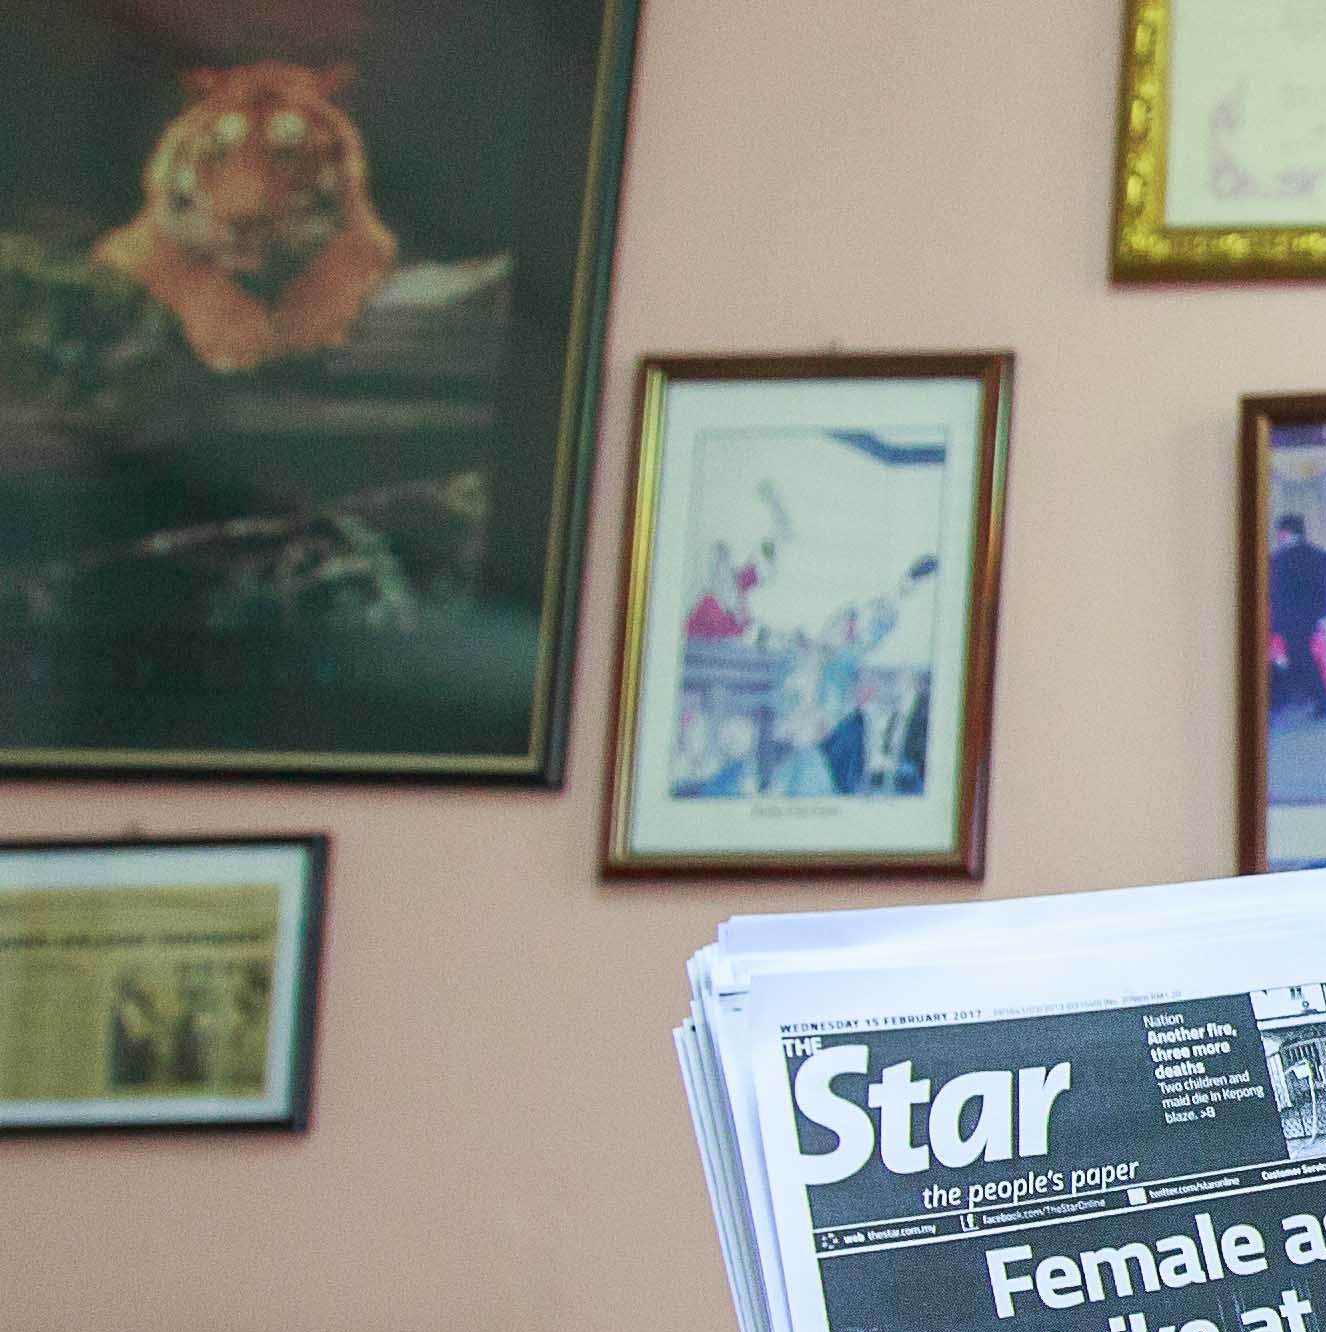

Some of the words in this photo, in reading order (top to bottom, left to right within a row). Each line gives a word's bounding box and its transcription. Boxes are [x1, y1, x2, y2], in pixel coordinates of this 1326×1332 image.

[779, 1020, 859, 1034] WEDNESDAY
[866, 1018, 880, 1027] 15
[884, 1013, 949, 1026] FEBRUARY
[953, 1009, 982, 1021] 2017
[1142, 1013, 1184, 1028] Nation
[1147, 1026, 1206, 1045] Another
[783, 1037, 822, 1057] THE
[1150, 1046, 1191, 1062] three
[1192, 1041, 1231, 1057] more
[1154, 1060, 1205, 1080] deaths
[1157, 1081, 1183, 1094] Two
[1183, 1075, 1228, 1091] children
[1228, 1070, 1250, 1085] and
[1161, 1093, 1191, 1109] maid
[1191, 1091, 1210, 1104] die
[1210, 1089, 1221, 1102] in
[1222, 1085, 1265, 1101] Kepong
[794, 1044, 1071, 1185] Star
[1165, 1110, 1199, 1124] blaze.
[922, 1184, 962, 1209] the
[968, 1169, 1064, 1209] people's
[1070, 1160, 1139, 1194] paper
[843, 1232, 865, 1245] web
[984, 1213, 1268, 1319] Female
